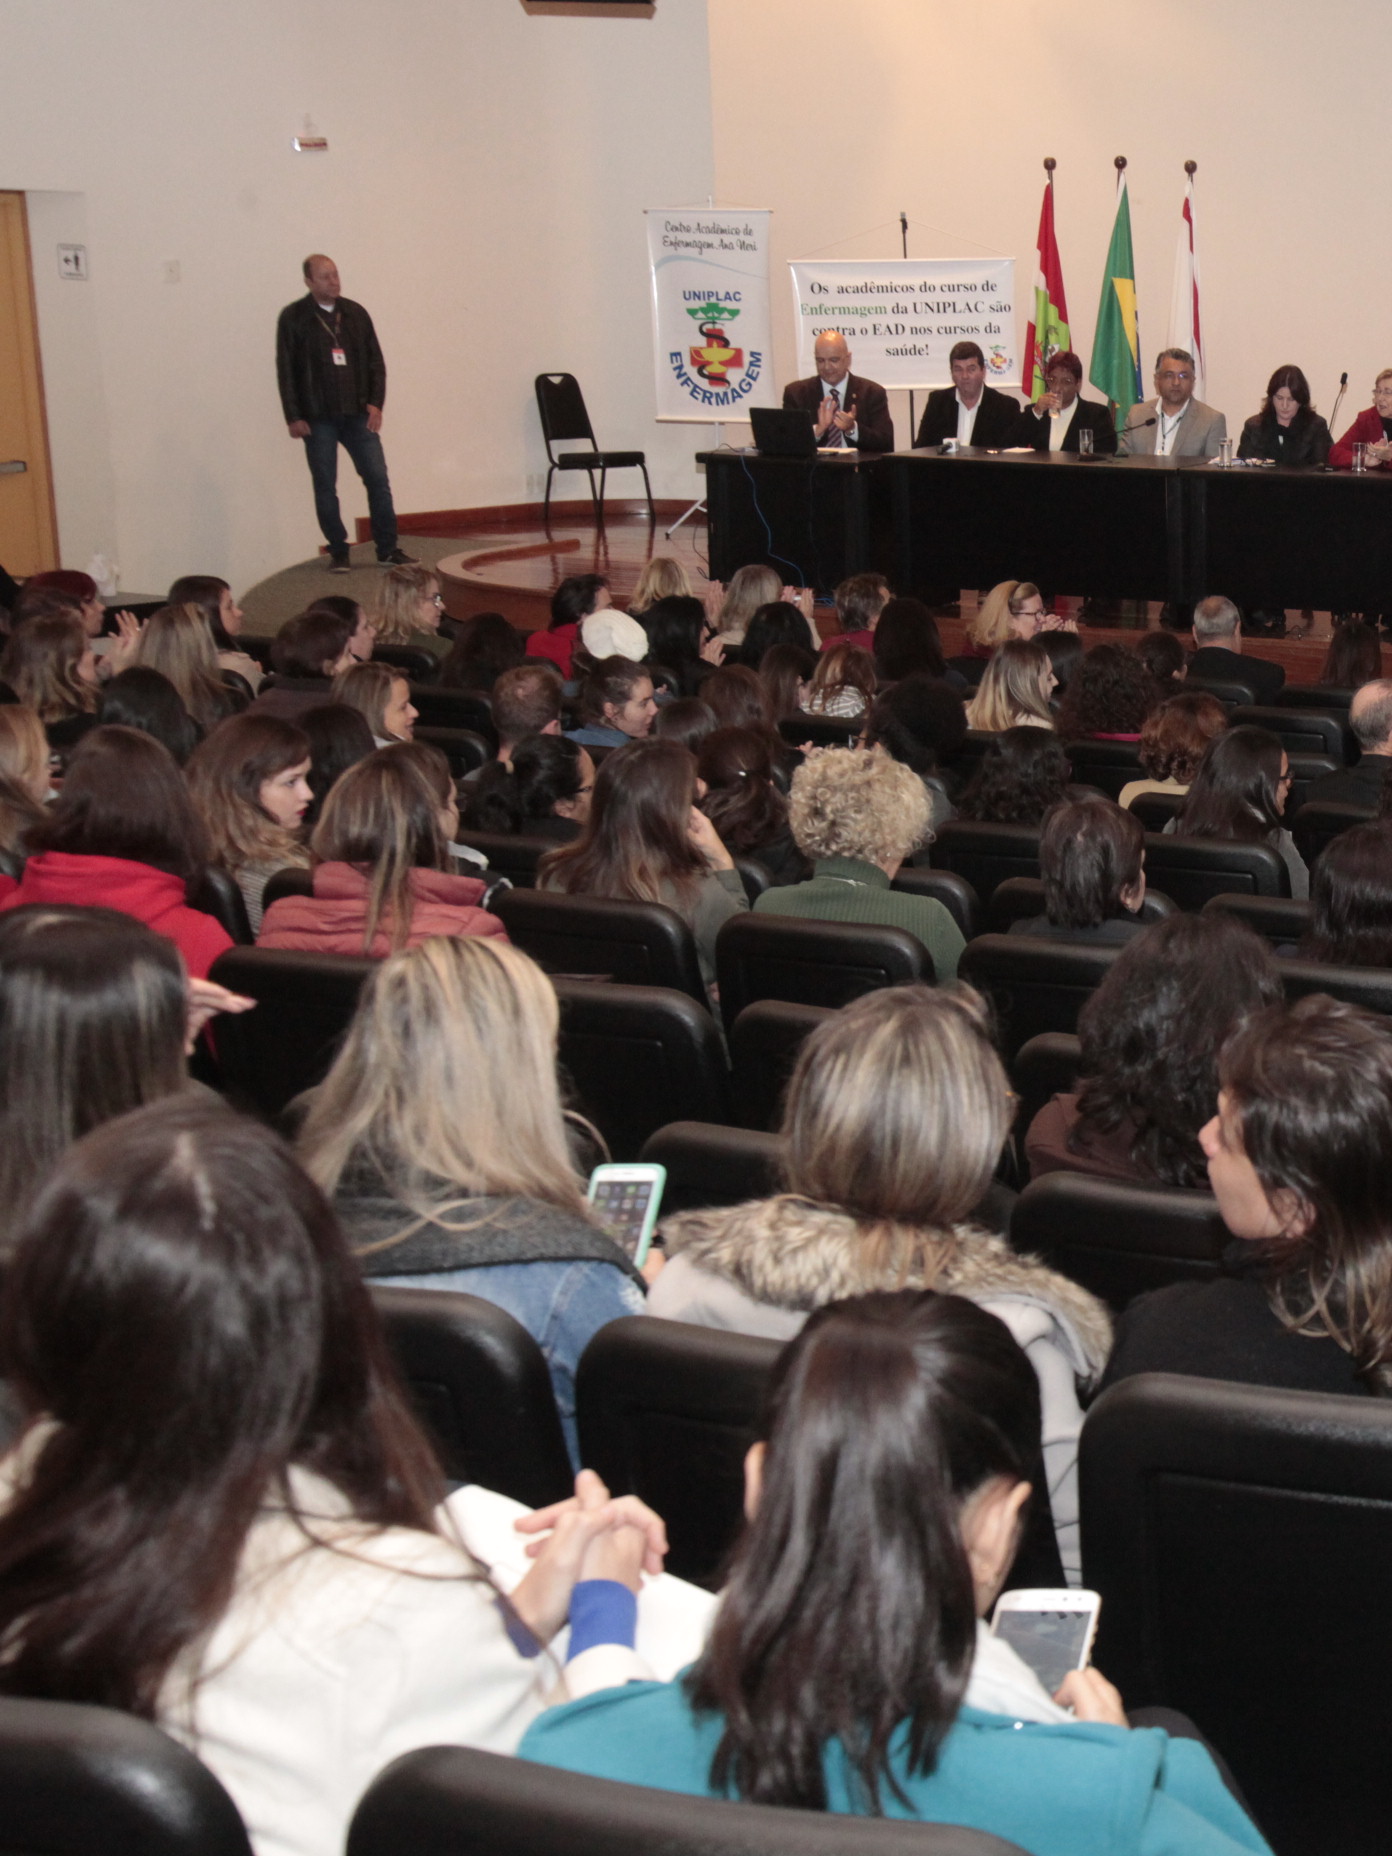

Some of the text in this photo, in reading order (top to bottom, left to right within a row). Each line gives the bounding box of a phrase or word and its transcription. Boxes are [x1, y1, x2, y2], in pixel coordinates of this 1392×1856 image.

[664, 220, 692, 234] Centro
[743, 223, 754, 237] de
[662, 235, 714, 256] Enfermagem
[810, 279, 998, 295] Os acadêmicos do curso de
[682, 289, 742, 302] UNIPLAC
[800, 300, 1012, 318] Enfermagem da UNIPLAC são
[860, 326, 869, 337] o
[872, 322, 906, 336] EAD
[909, 325, 933, 336] nos
[936, 325, 981, 335] cursos
[984, 321, 1001, 335] da
[885, 343, 930, 357] saúde!
[669, 350, 763, 407] ENFERMAGEM
